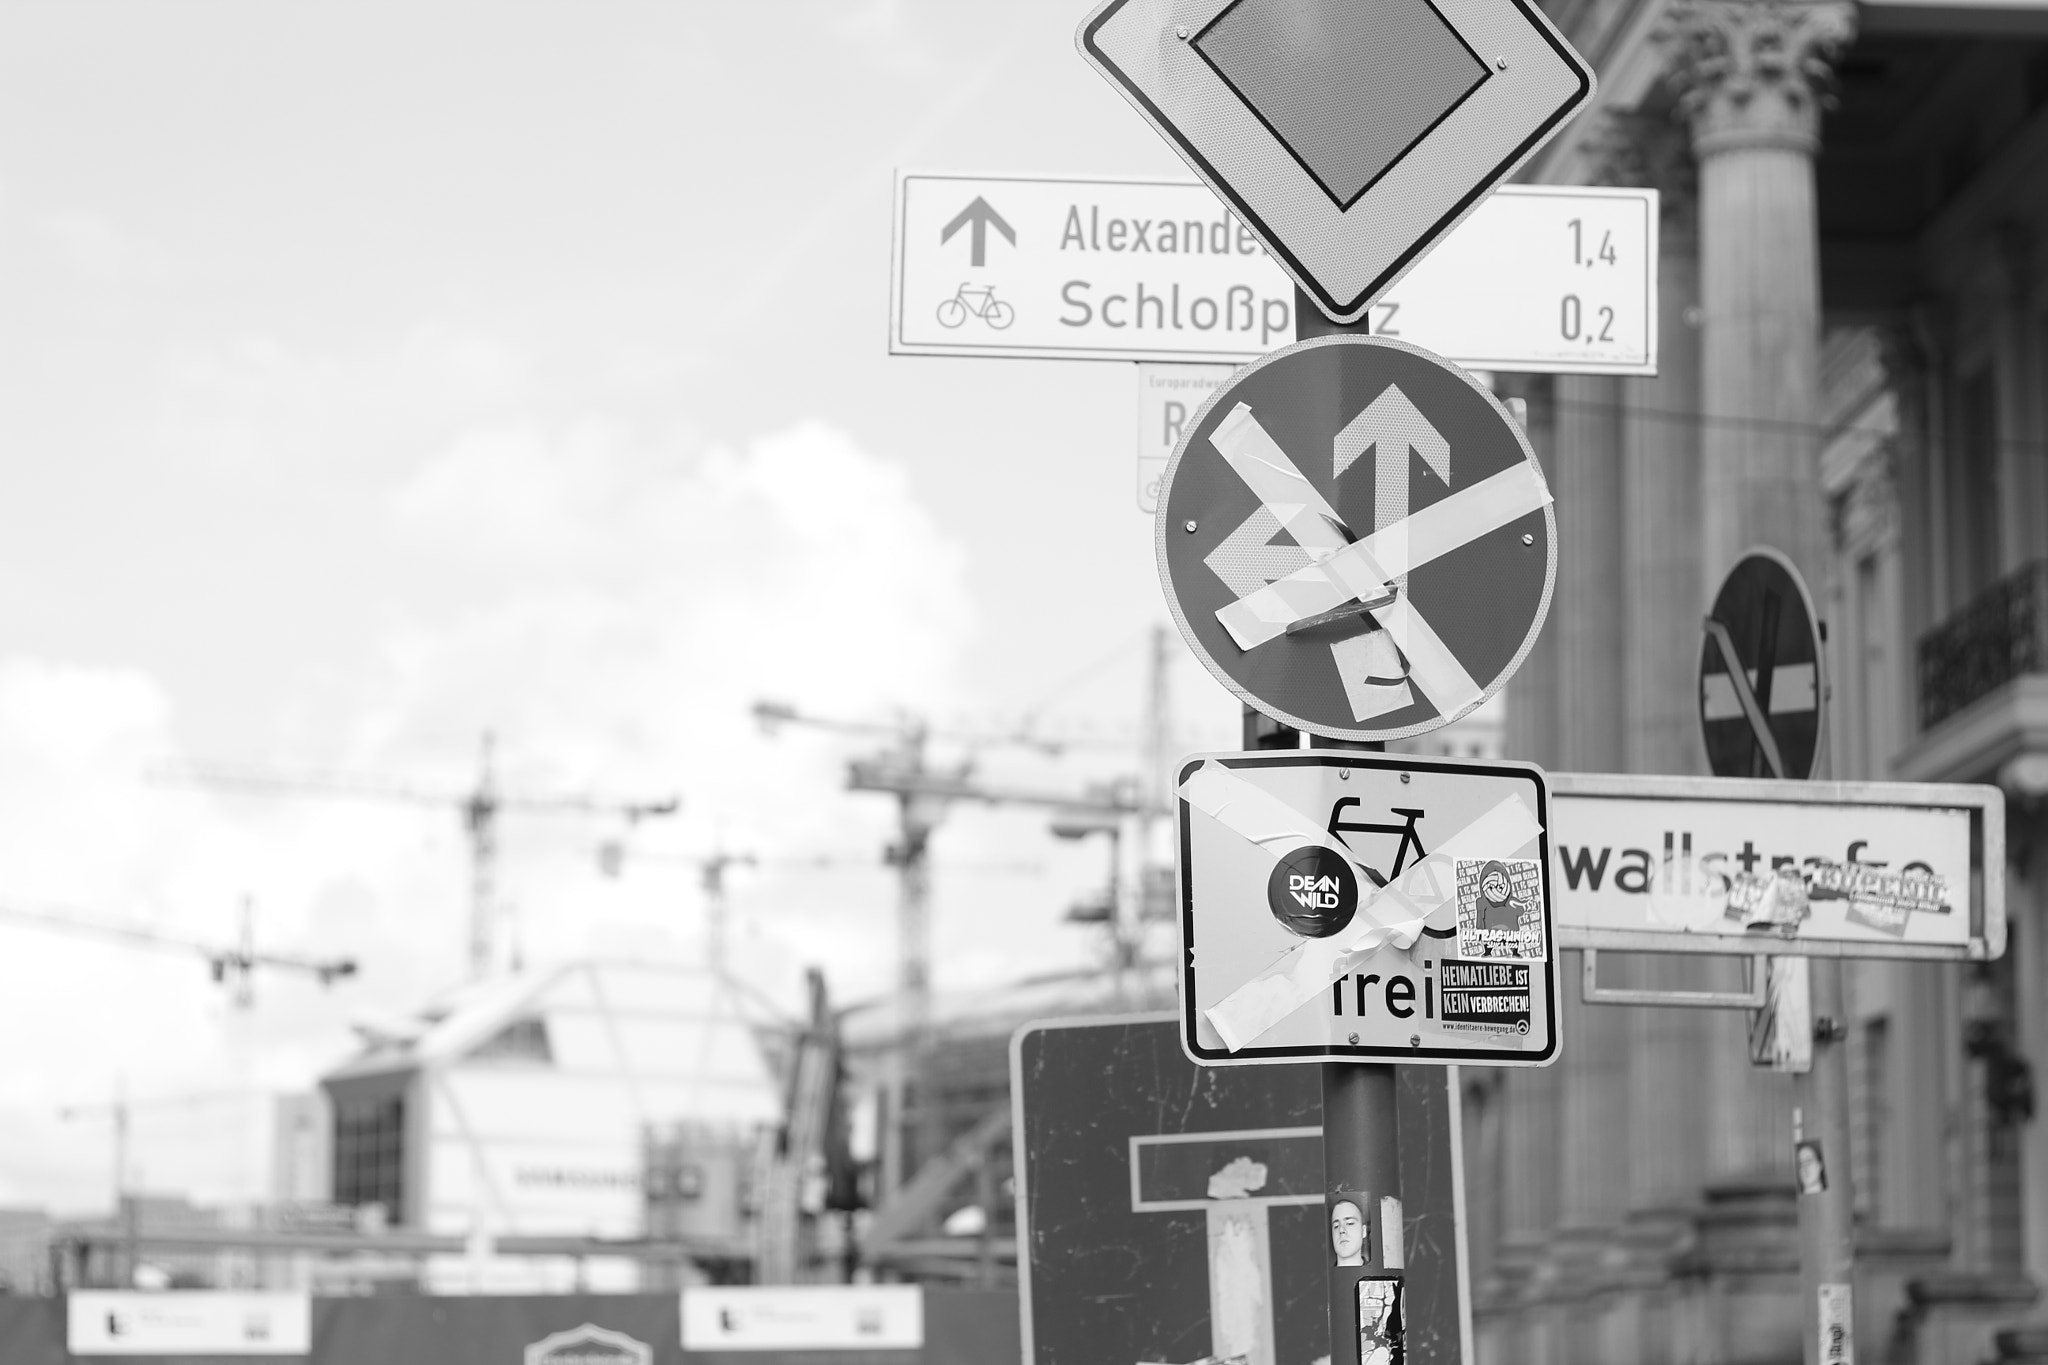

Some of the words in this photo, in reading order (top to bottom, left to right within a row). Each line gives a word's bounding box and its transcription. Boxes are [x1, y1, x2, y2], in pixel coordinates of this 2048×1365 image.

[1060, 205, 1268, 256] Alexande
[1568, 218, 1616, 268] 1,4
[1059, 280, 1401, 345] Schloßpz
[1561, 294, 1614, 344] 0,2
[1164, 400, 1203, 446] R
[1289, 874, 1340, 894] DEAN
[1289, 891, 1339, 910] WILD
[1330, 957, 1433, 1019] frei
[1442, 965, 1513, 986] HEIMATLIEBE
[1515, 969, 1528, 985] IST
[1443, 993, 1469, 1014] KEIN
[1470, 995, 1530, 1013] VERBRECHEN!
